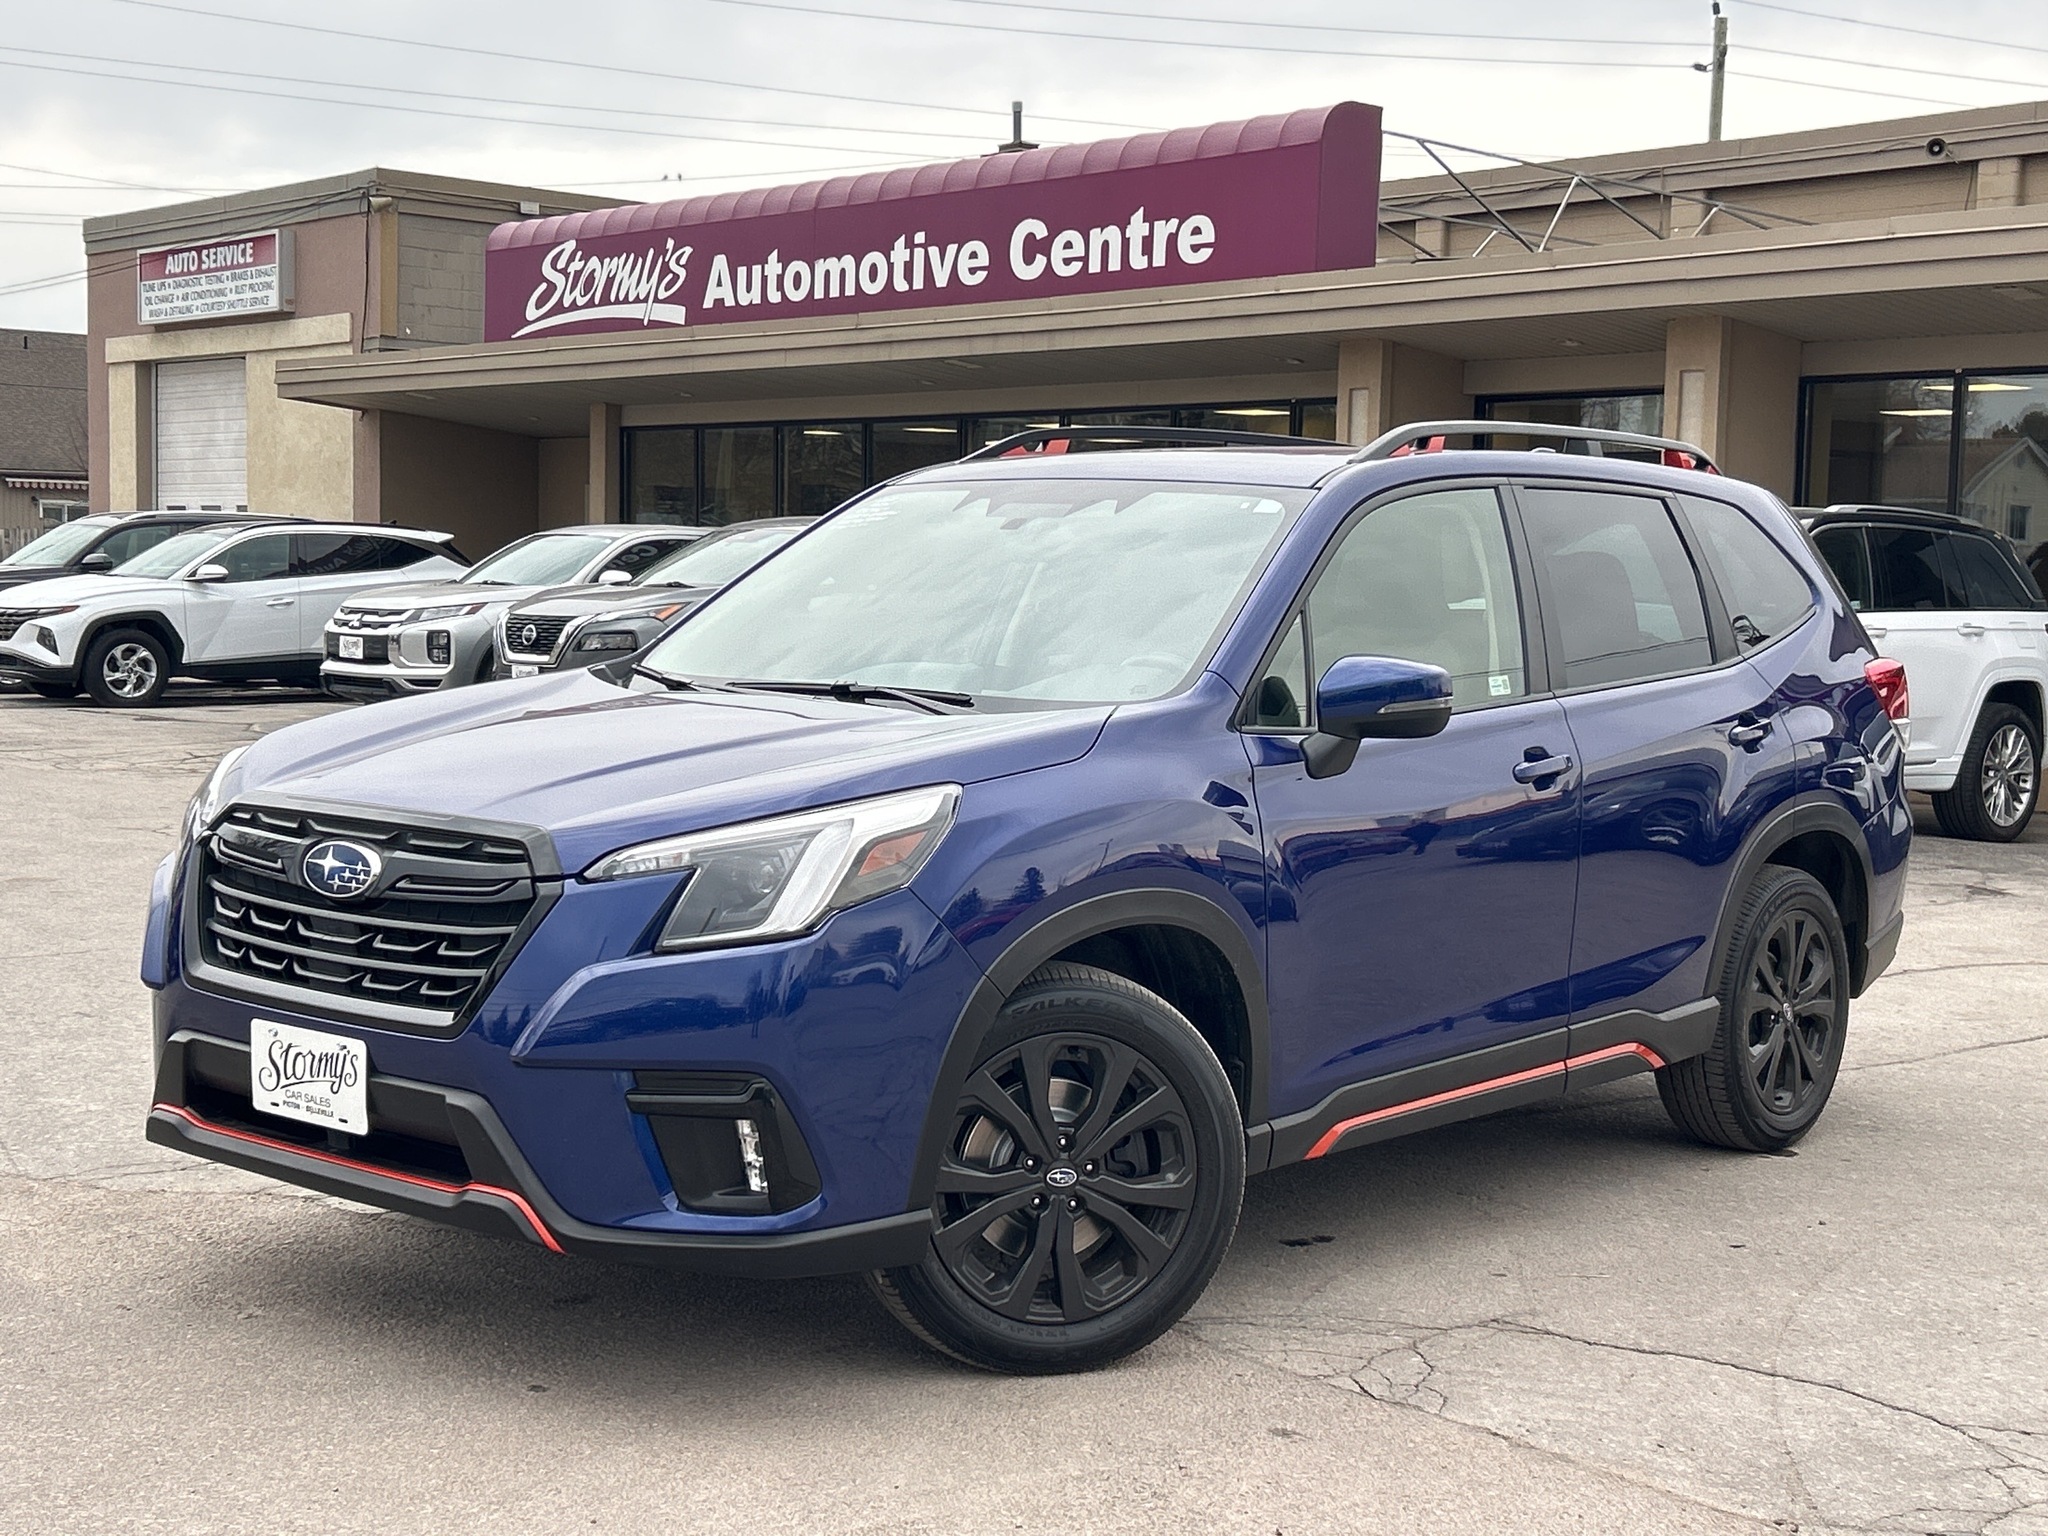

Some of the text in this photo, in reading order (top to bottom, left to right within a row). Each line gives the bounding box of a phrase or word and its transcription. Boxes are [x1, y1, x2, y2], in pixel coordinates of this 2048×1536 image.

[165, 242, 254, 275] AUTO SERVICE
[525, 206, 1216, 327] Stormy's Automotive Centre
[157, 281, 167, 292] UPS
[231, 270, 249, 282] BRAKES
[144, 296, 154, 306] OIL
[154, 293, 175, 305] CHANGE
[181, 292, 190, 302] AIR
[259, 1040, 359, 1095] Stormy's
[284, 1089, 332, 1108] CAR SALES
